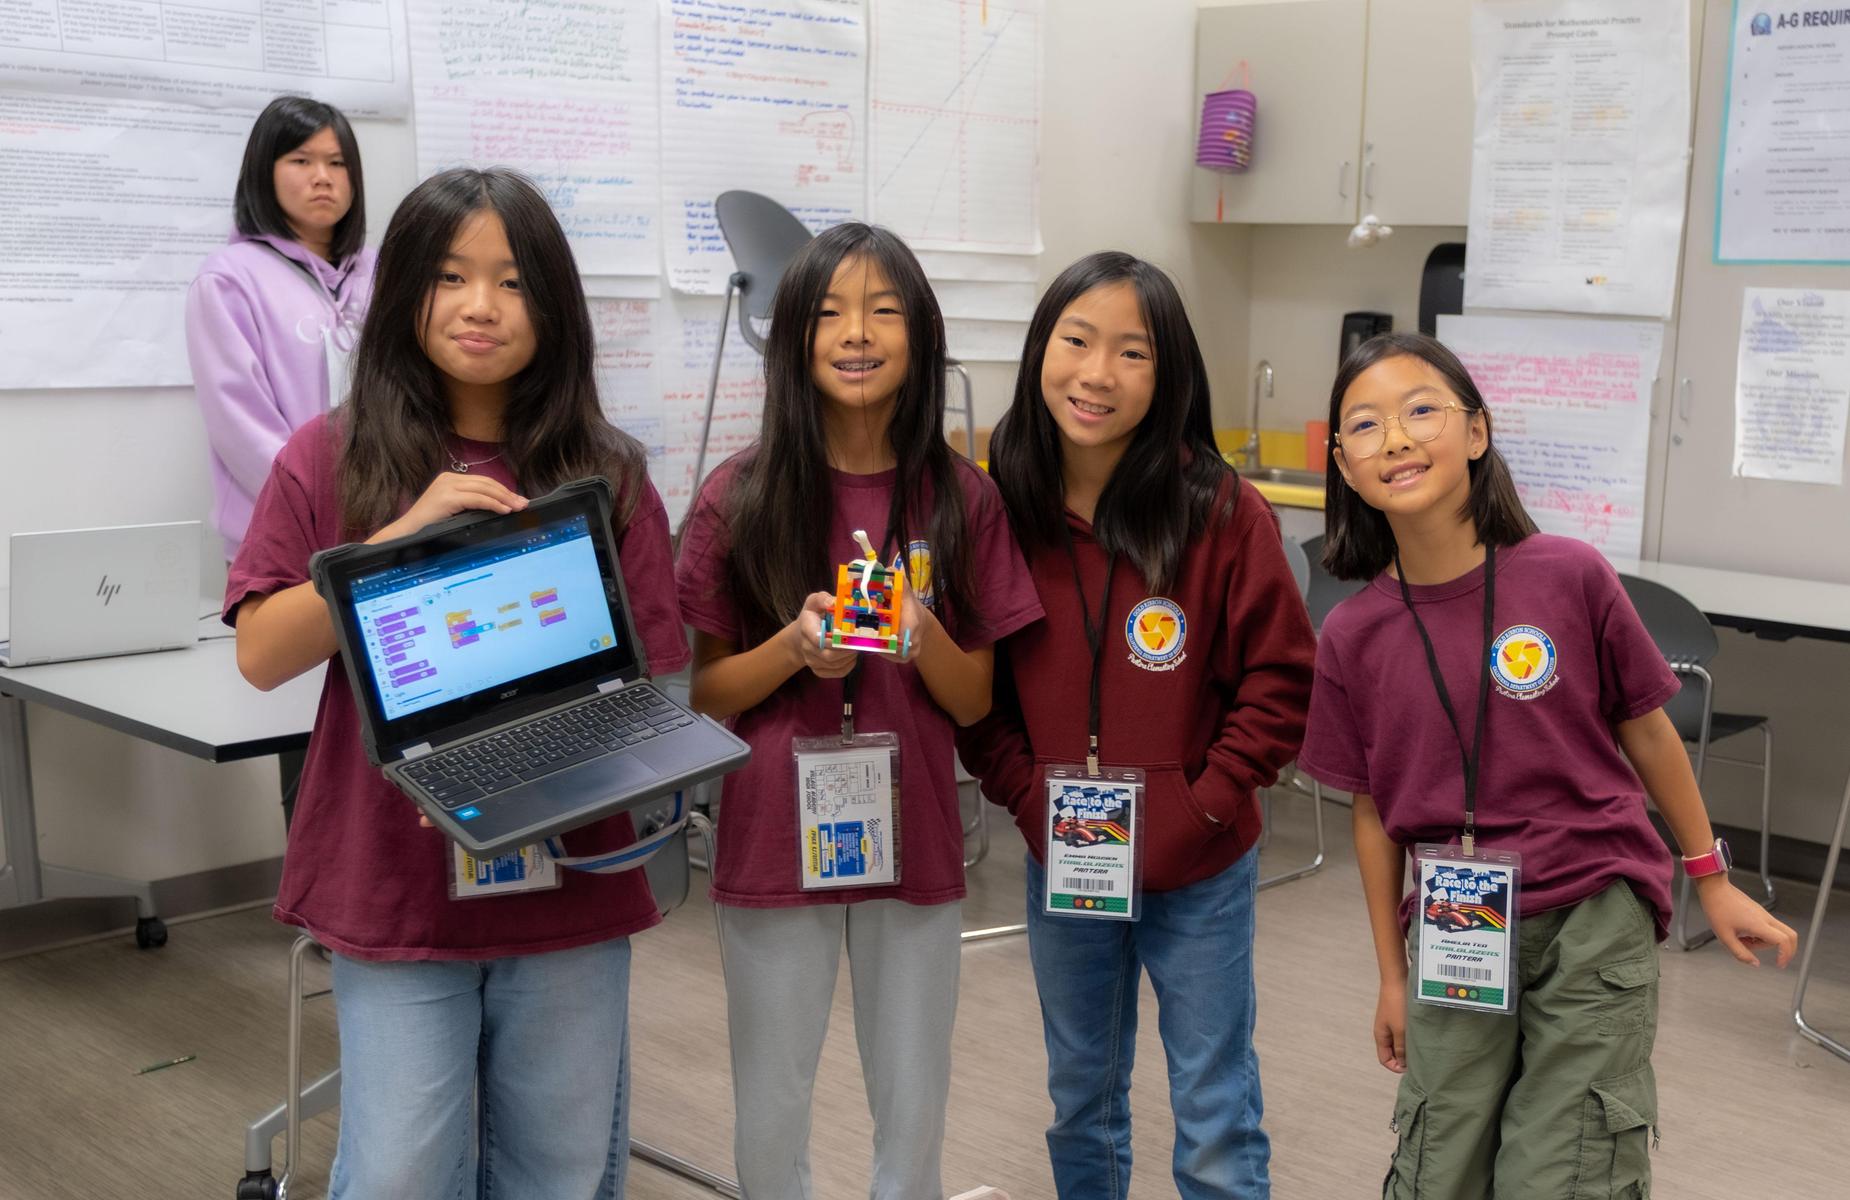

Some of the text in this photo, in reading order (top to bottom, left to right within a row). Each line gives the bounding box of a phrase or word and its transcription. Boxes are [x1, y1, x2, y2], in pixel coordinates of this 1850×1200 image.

[1504, 15, 1641, 30] Standards for Mathematical Practice
[1777, 13, 1799, 29] A-G
[500, 689, 519, 700] acer
[1063, 794, 1123, 809] Race to the
[1077, 808, 1108, 821] Finish
[1073, 867, 1109, 875] PANTERA
[1435, 875, 1499, 892] Race to the
[1450, 890, 1483, 905] Finish
[1445, 953, 1483, 963] PANTERA
